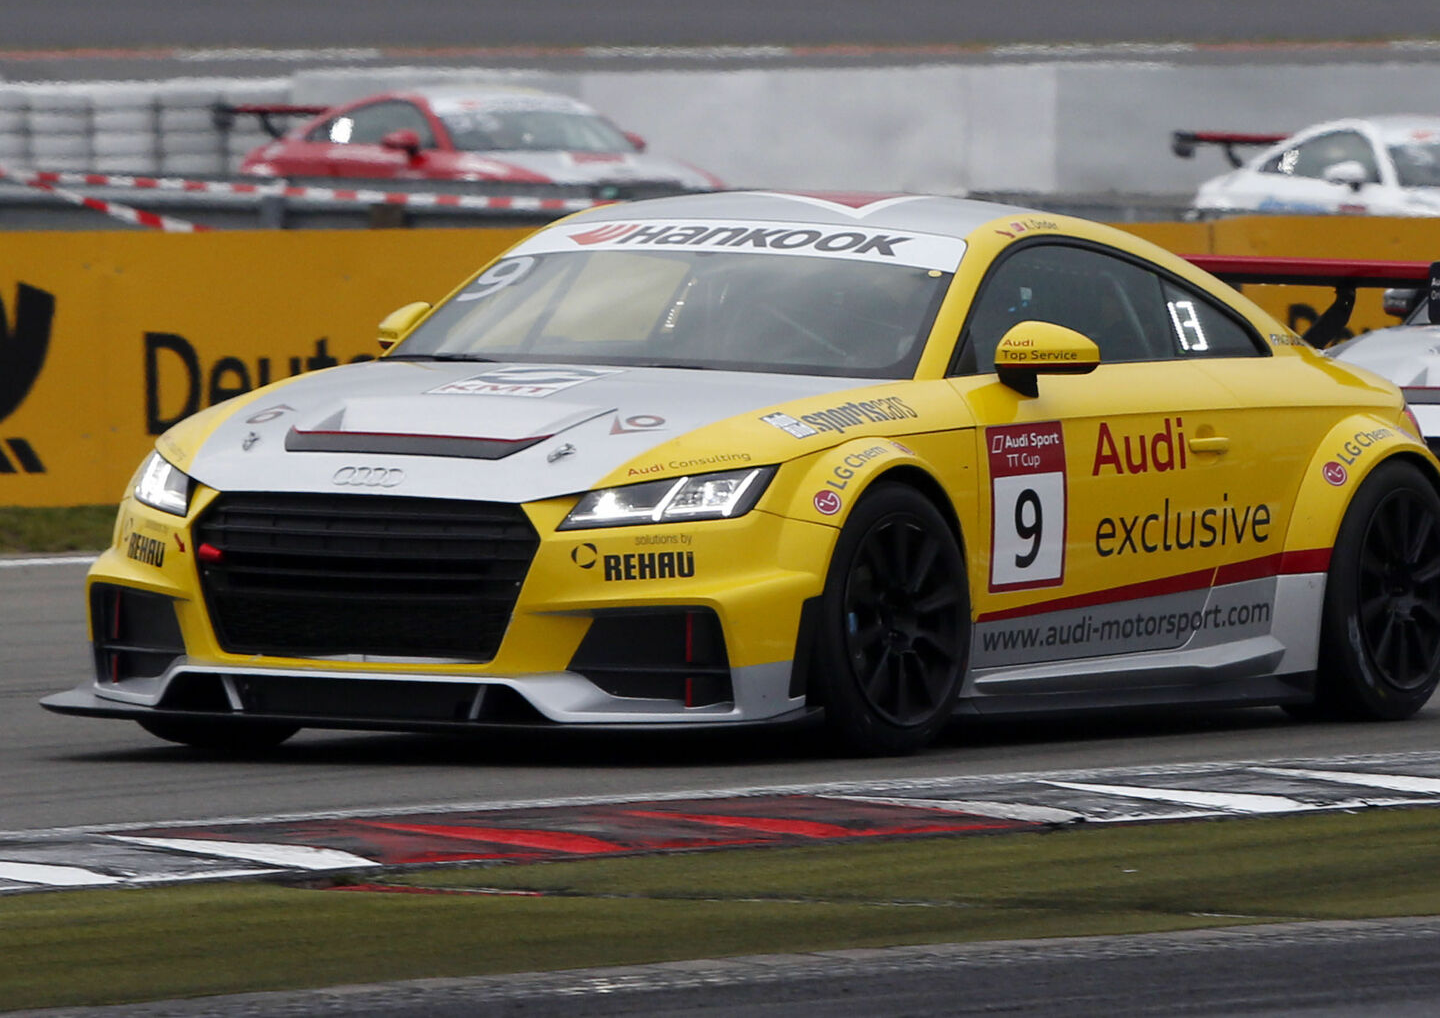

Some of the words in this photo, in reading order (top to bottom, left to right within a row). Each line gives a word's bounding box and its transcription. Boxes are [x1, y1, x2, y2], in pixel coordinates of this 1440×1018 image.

[456, 256, 535, 302] 9
[1002, 339, 1034, 347] Audi
[1002, 349, 1028, 362] Top
[1031, 349, 1077, 361] Service
[801, 396, 918, 434] sportscars
[1005, 432, 1028, 449] Audi
[1031, 432, 1060, 447] Sport
[1092, 417, 1187, 477] Audi
[1336, 441, 1363, 466] LG
[628, 463, 665, 476] Audi
[668, 452, 751, 470] Consulting
[826, 466, 854, 490] LG
[844, 445, 886, 469] Chem
[1006, 454, 1019, 467] TT
[1021, 452, 1041, 468] Cup
[634, 534, 677, 546] solutions
[680, 533, 693, 546] by
[1015, 488, 1043, 569] 9
[1095, 493, 1271, 557] exclusive
[127, 532, 166, 568] REHAU
[604, 551, 695, 581] REHAU
[983, 600, 1270, 651] www.audi-motorsport.com
